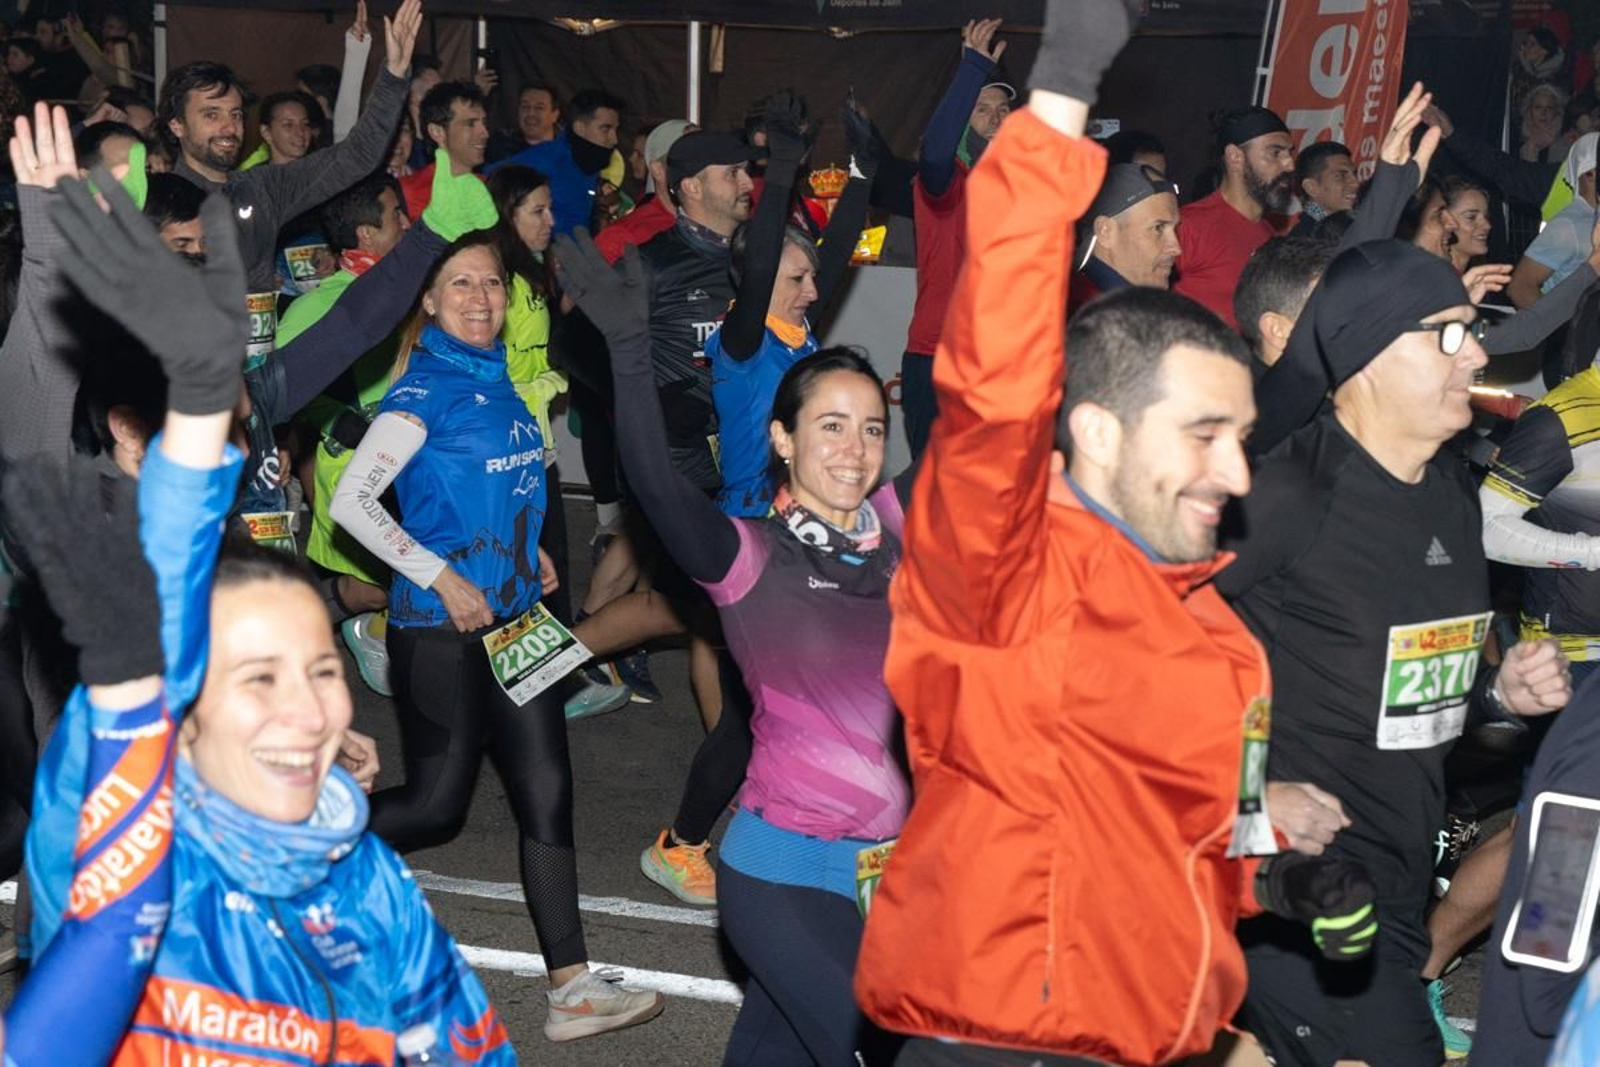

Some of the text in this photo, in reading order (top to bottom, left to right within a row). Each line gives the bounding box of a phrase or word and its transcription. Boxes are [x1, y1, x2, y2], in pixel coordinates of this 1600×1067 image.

[496, 624, 563, 681] 2209
[1396, 650, 1480, 705] 2370
[161, 987, 320, 1054] Maratón
